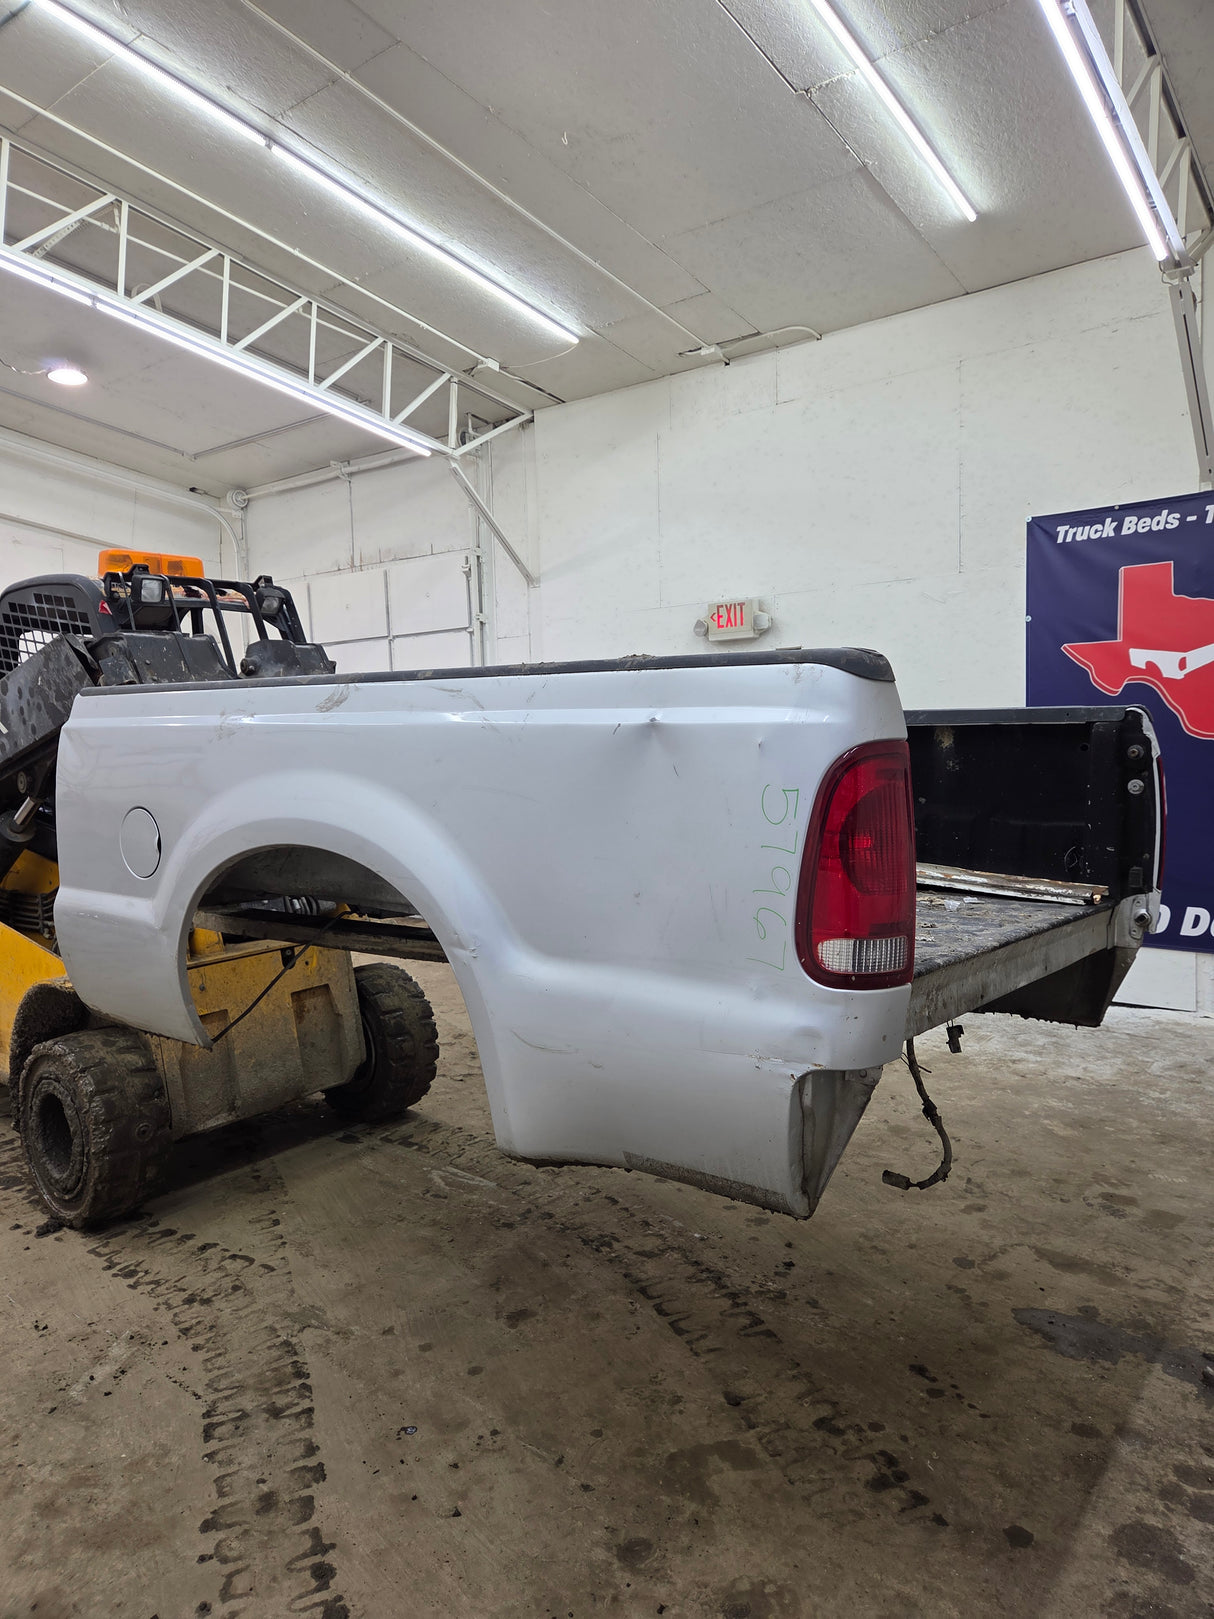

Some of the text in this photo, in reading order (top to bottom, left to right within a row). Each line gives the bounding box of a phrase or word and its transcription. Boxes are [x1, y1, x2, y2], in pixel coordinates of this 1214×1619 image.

[1056, 517, 1118, 544] Truck
[1121, 509, 1181, 536] Beds
[716, 602, 746, 629] EXIT
[745, 784, 800, 971] 57967
